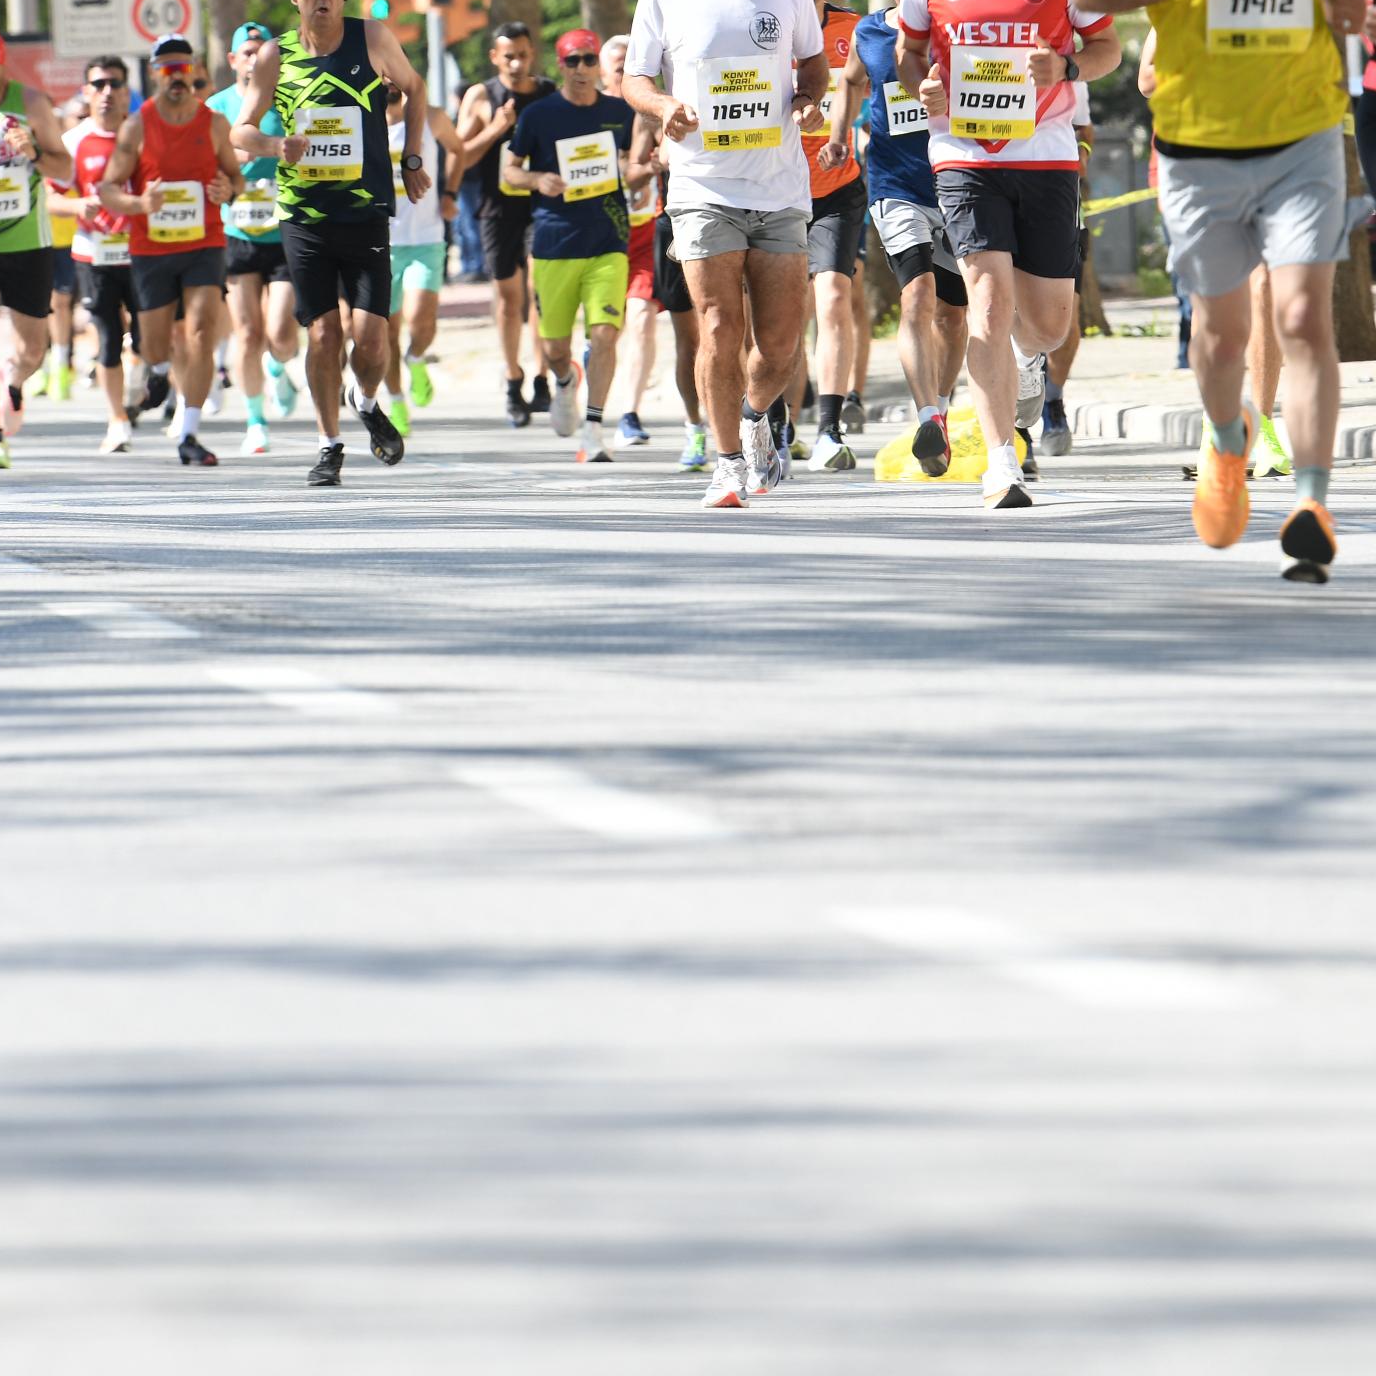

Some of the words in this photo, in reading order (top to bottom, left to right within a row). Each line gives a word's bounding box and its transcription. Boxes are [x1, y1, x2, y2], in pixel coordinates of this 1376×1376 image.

[143, 0, 183, 28] 60
[976, 60, 1010, 69] KONYA
[723, 70, 757, 80] KONYA
[712, 83, 768, 94] MARATONU
[959, 92, 1026, 110] 10904
[712, 101, 771, 121] 11644
[569, 164, 609, 181] 11404
